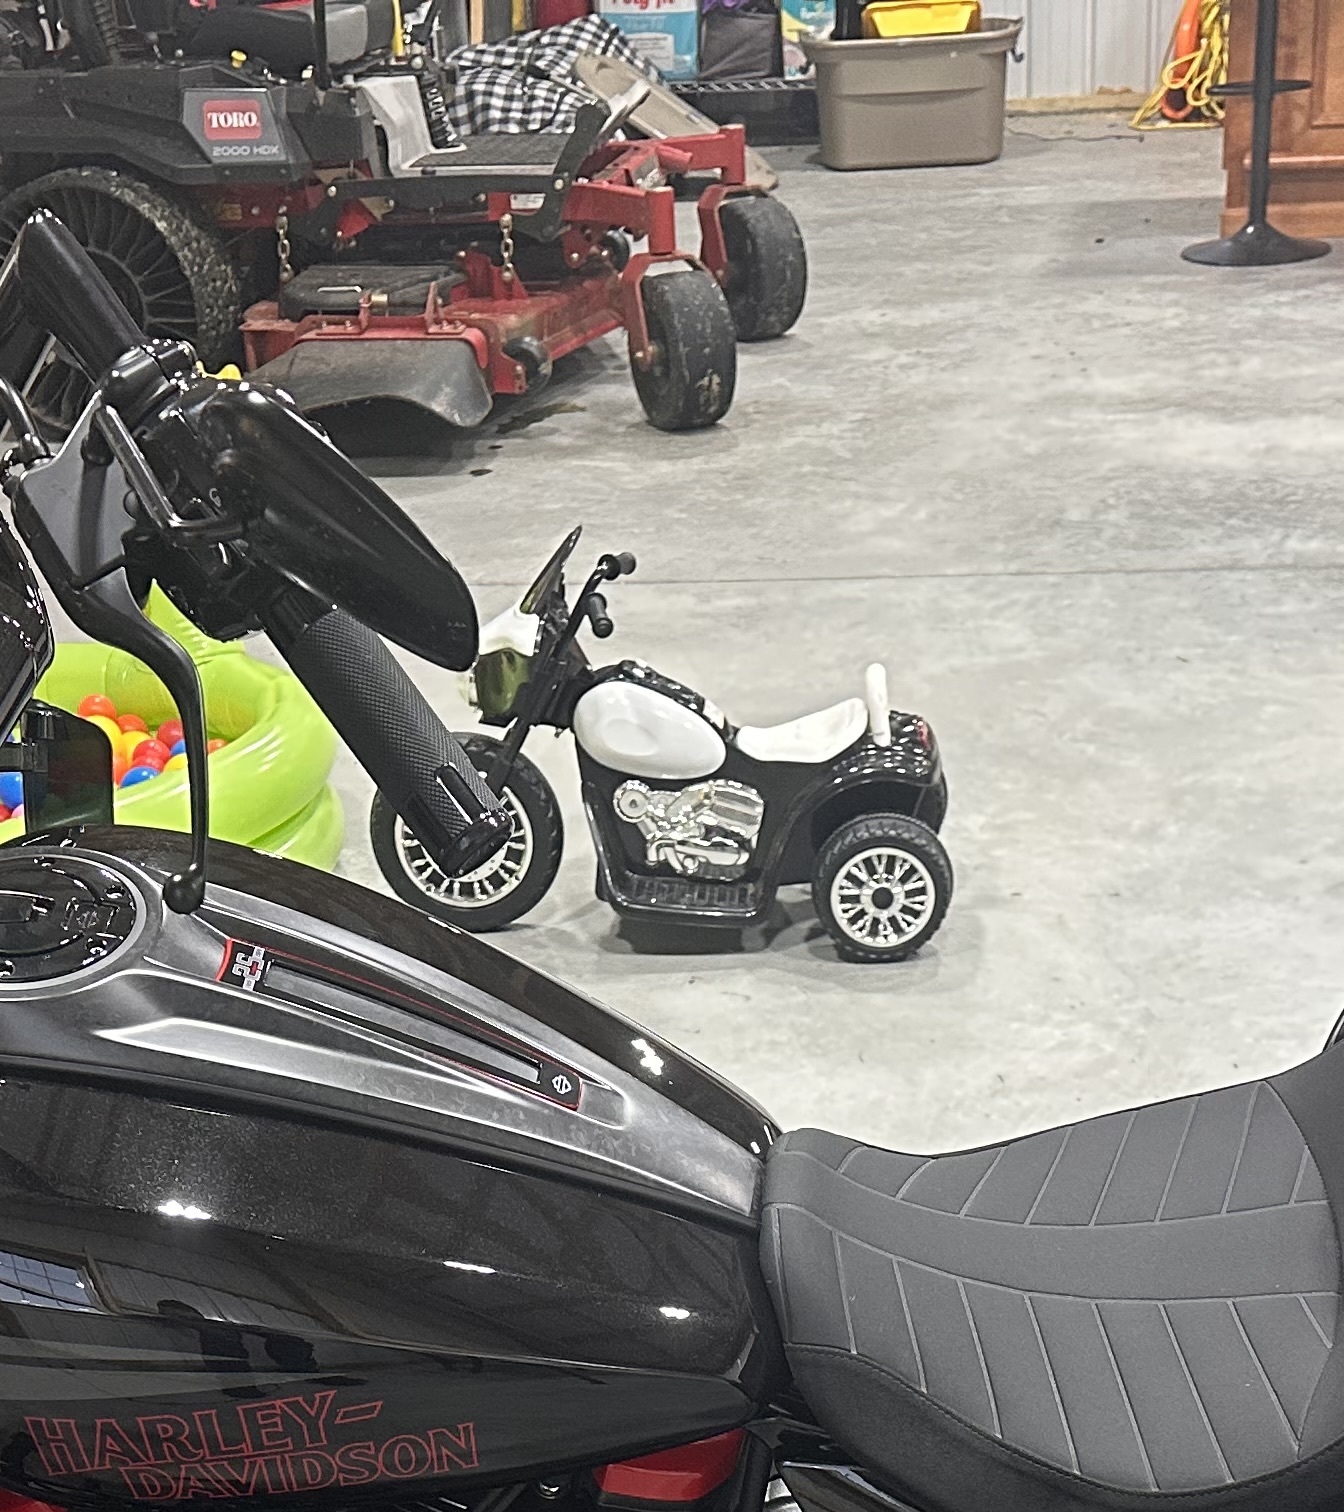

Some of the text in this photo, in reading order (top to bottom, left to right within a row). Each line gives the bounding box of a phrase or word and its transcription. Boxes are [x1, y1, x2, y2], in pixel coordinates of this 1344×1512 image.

[207, 112, 258, 128] TORO
[212, 145, 279, 156] 2000 HDX
[24, 1390, 383, 1476] HARLEY-
[119, 1422, 479, 1499] DAVIDSON
